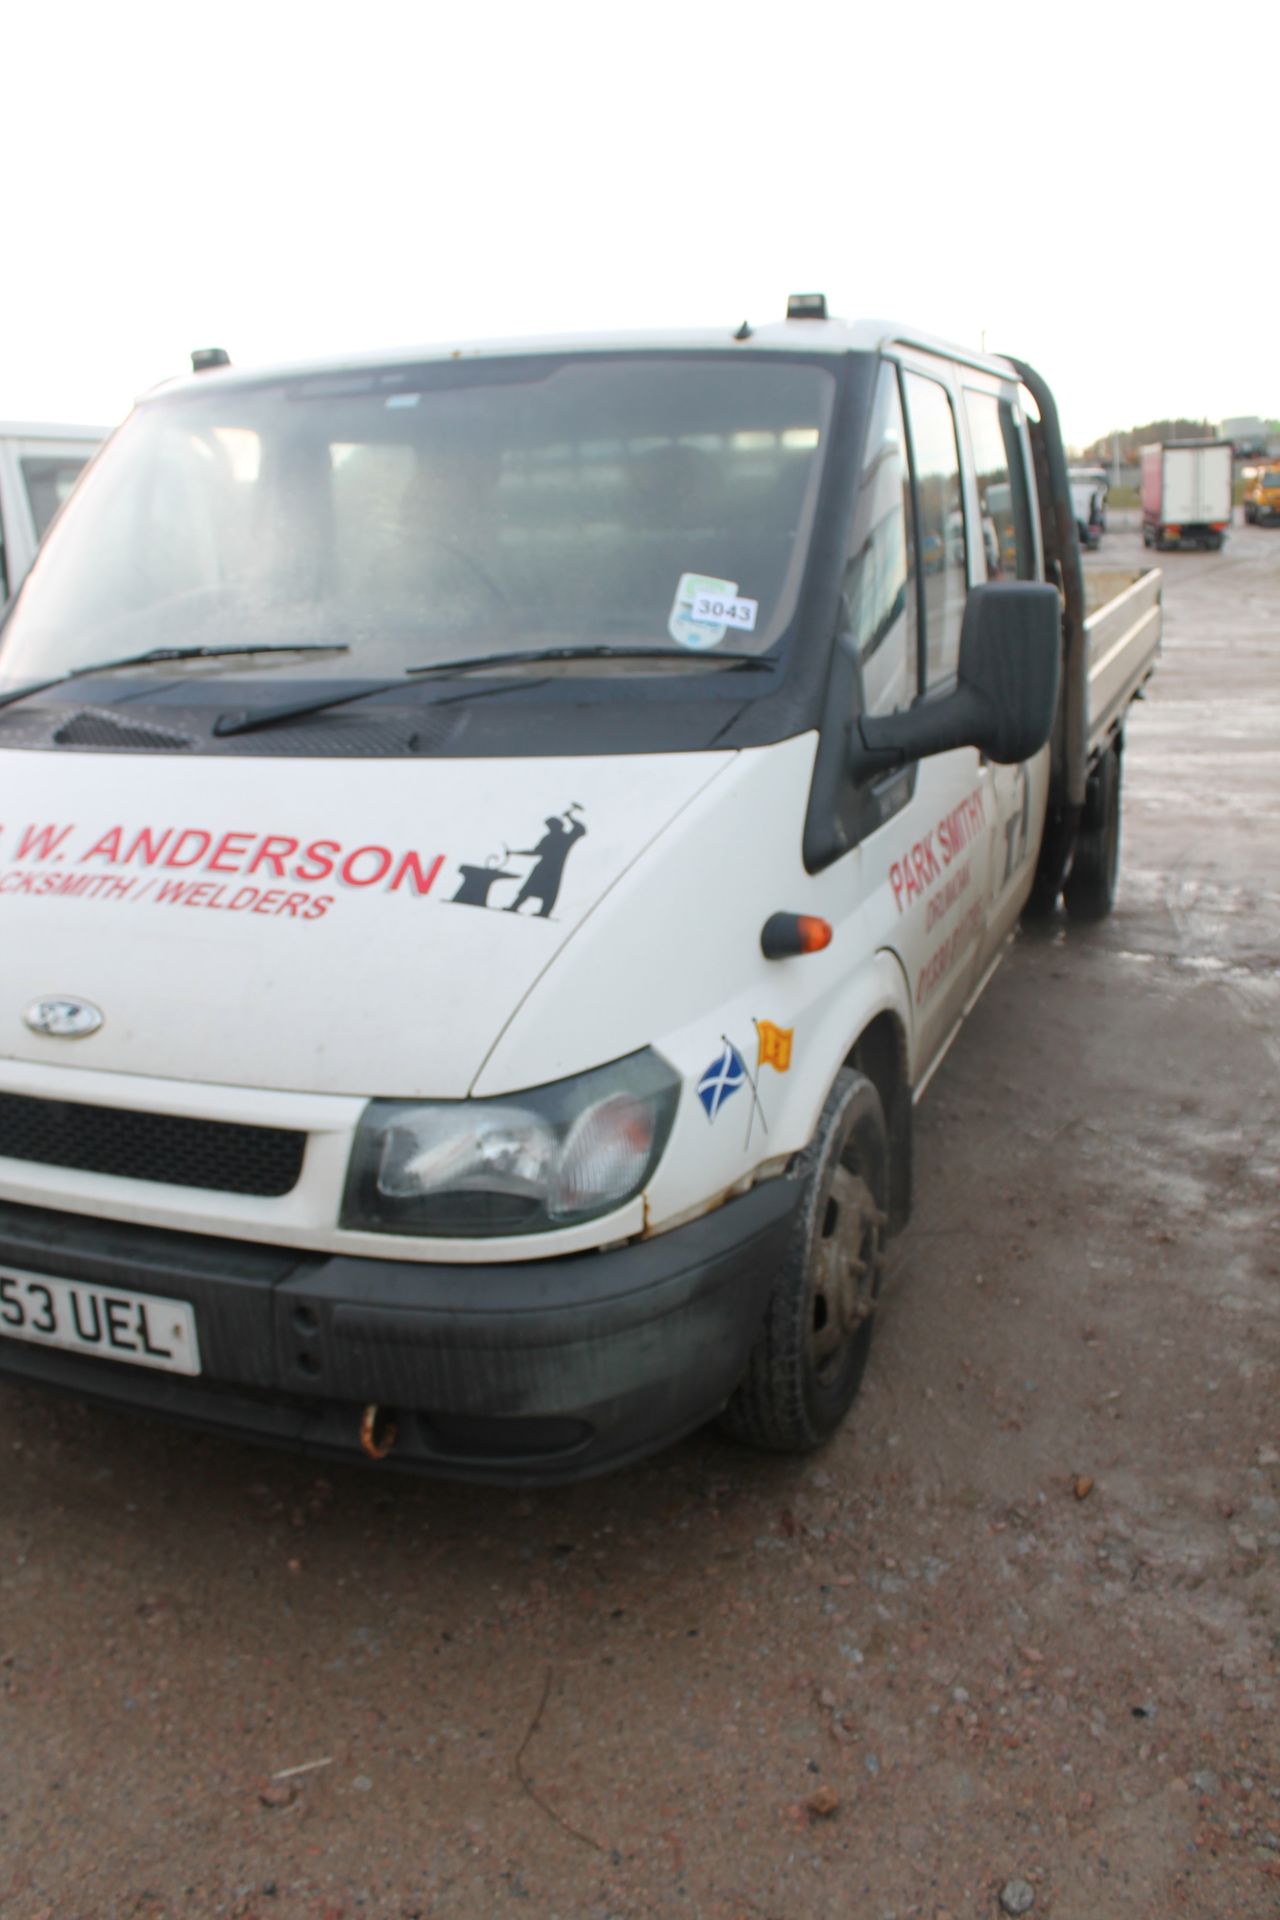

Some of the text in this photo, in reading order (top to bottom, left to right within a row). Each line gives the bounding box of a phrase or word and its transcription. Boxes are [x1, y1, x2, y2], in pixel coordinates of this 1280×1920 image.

[698, 599, 751, 621] 3043
[16, 824, 445, 896] W. ANDERSON
[889, 830, 941, 913] PARK
[155, 881, 335, 919] WELDERS
[0, 1277, 173, 1358] 53 UEL
